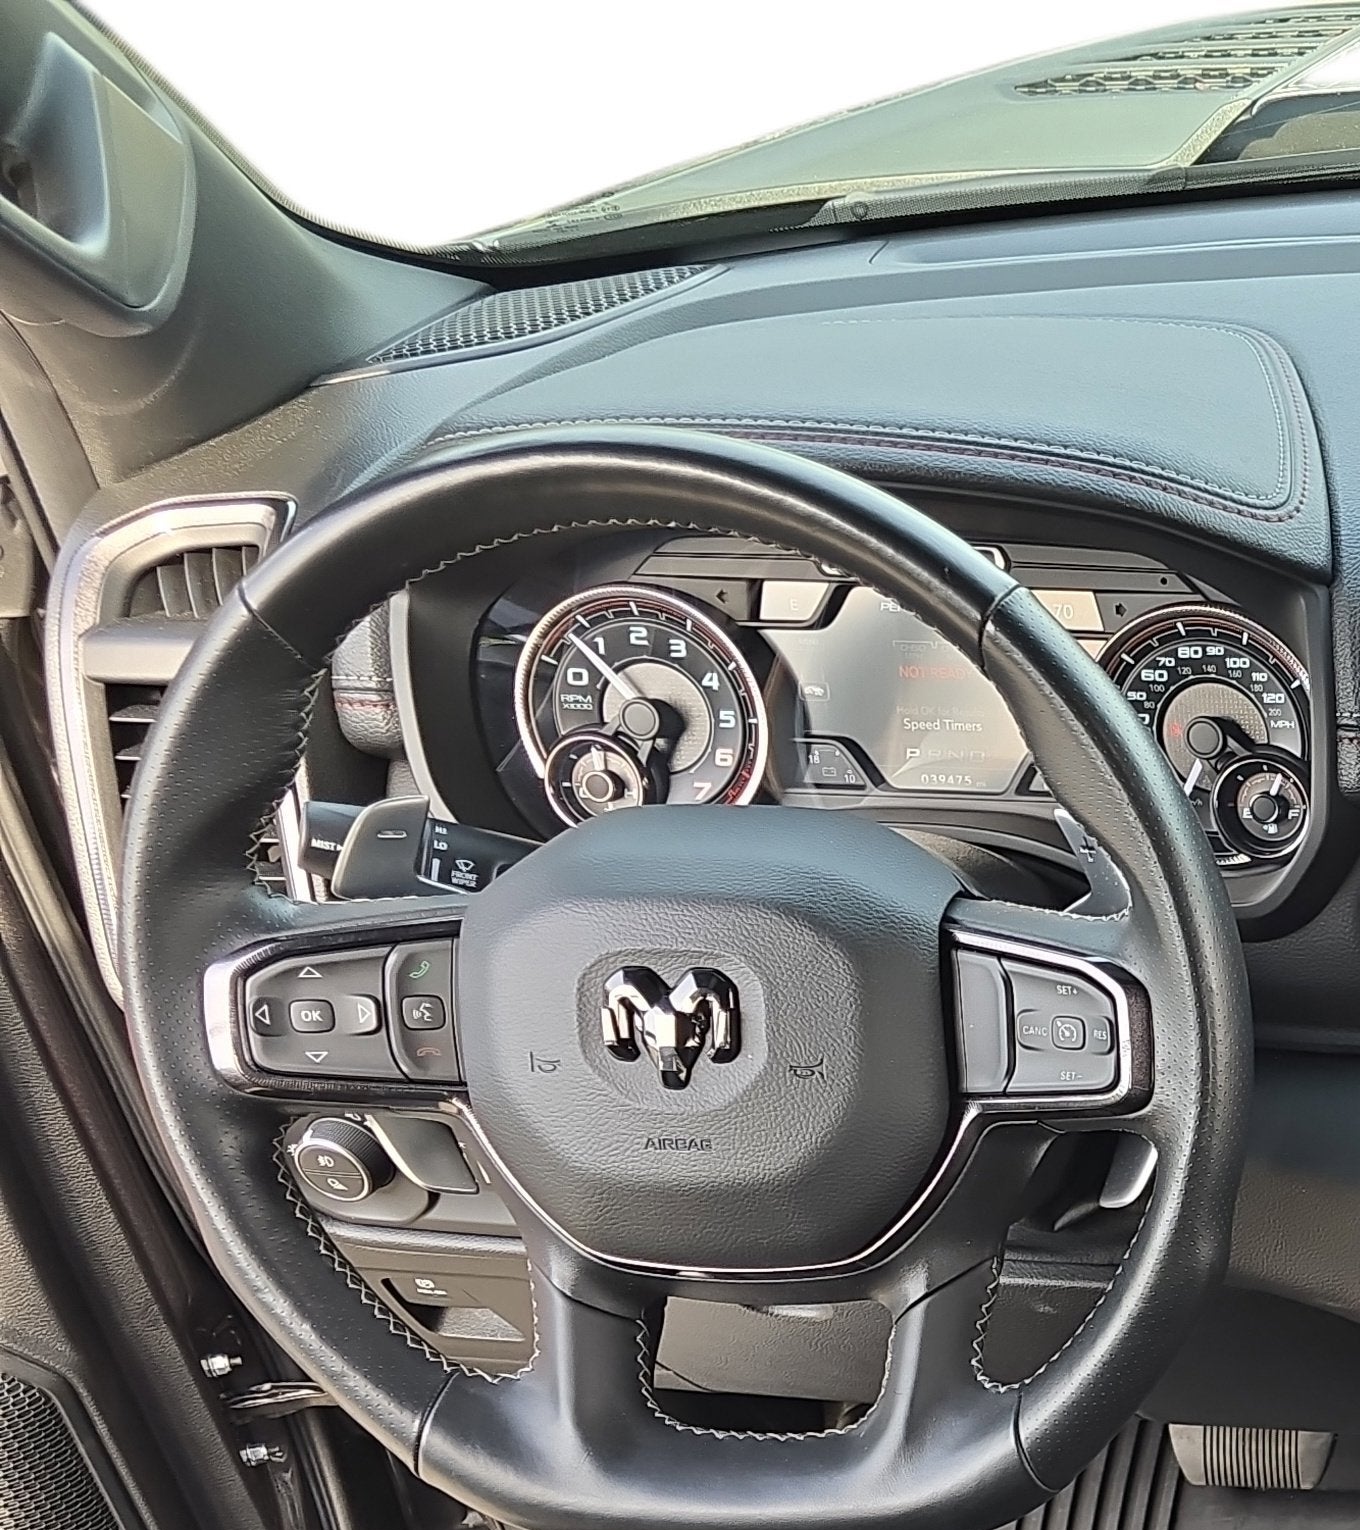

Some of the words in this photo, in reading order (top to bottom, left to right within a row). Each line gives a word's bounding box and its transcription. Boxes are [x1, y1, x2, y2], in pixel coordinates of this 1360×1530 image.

[1053, 604, 1074, 619] 70
[629, 627, 649, 645] 2
[593, 638, 605, 655] 1
[669, 639, 687, 658] 3
[1177, 646, 1202, 658] 80
[1206, 646, 1224, 655] 90
[1156, 657, 1175, 666] 70
[1225, 657, 1250, 668] 100
[1177, 666, 1192, 675] 120
[1202, 664, 1217, 673] 140
[566, 668, 589, 686] 0
[1141, 669, 1168, 682] 60
[1251, 672, 1268, 681] 110
[702, 672, 720, 691] 4
[1149, 684, 1165, 692] 100
[560, 694, 593, 703] RPM
[1262, 693, 1285, 704] 120
[719, 711, 736, 728] 5
[903, 718, 940, 732] Speed
[942, 719, 982, 732] Timers
[1270, 720, 1295, 729] MPH
[714, 749, 734, 767] 6
[906, 748, 920, 760] P
[844, 775, 856, 784] 10
[921, 774, 972, 785] 039475
[693, 782, 712, 800] 7
[1243, 808, 1253, 819] E
[1288, 809, 1300, 819] F
[311, 838, 336, 851] MIST
[433, 840, 448, 850] LO
[451, 870, 479, 881] FRONT
[300, 1009, 324, 1023] OK
[1022, 1025, 1048, 1036] CANC
[1093, 1029, 1107, 1040] RES
[644, 1137, 713, 1150] AIRBAG
